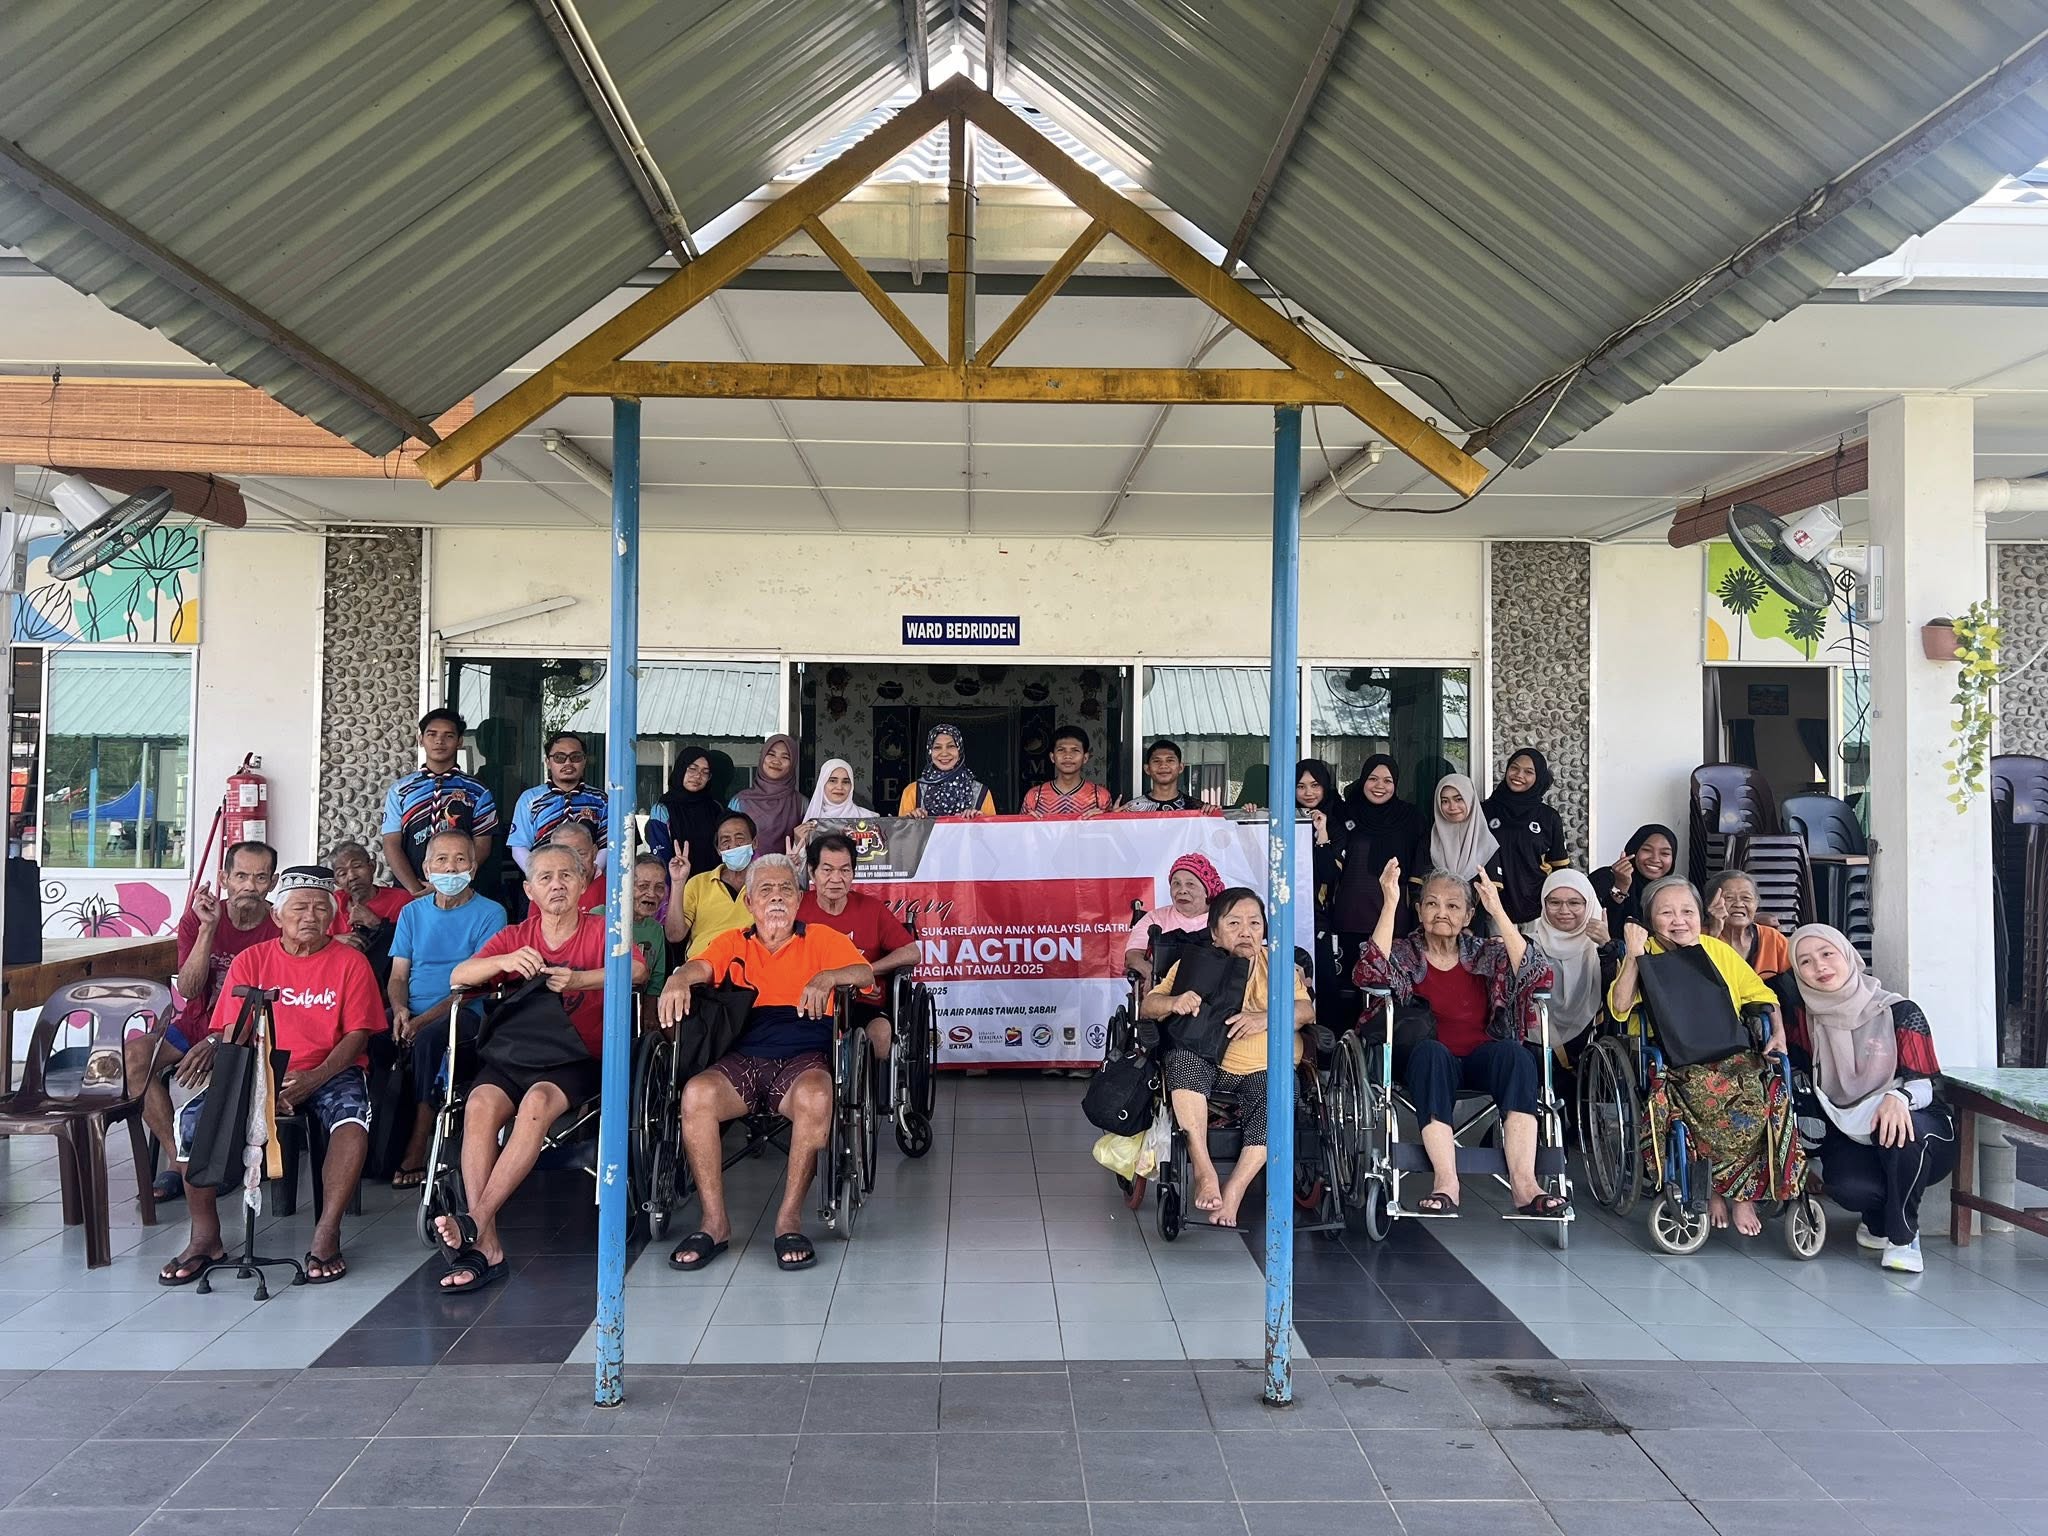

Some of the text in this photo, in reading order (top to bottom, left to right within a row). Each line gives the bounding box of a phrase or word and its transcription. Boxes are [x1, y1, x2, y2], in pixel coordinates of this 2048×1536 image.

[906, 622, 1016, 639] WARD BEDRIDDEN
[921, 925, 1002, 937] SUKARELAWAN
[1005, 925, 1035, 935] ANAK
[1037, 924, 1092, 934] MALAYSIA
[955, 936, 1082, 964] ACTION
[911, 963, 1044, 977] HAGIAN TAWAU 2025
[281, 987, 334, 1007] Sabah
[950, 1007, 964, 1016] AIR
[965, 1006, 994, 1016] PANAS
[996, 1006, 1027, 1015] TAWAU,
[1029, 1005, 1057, 1014] SABAH
